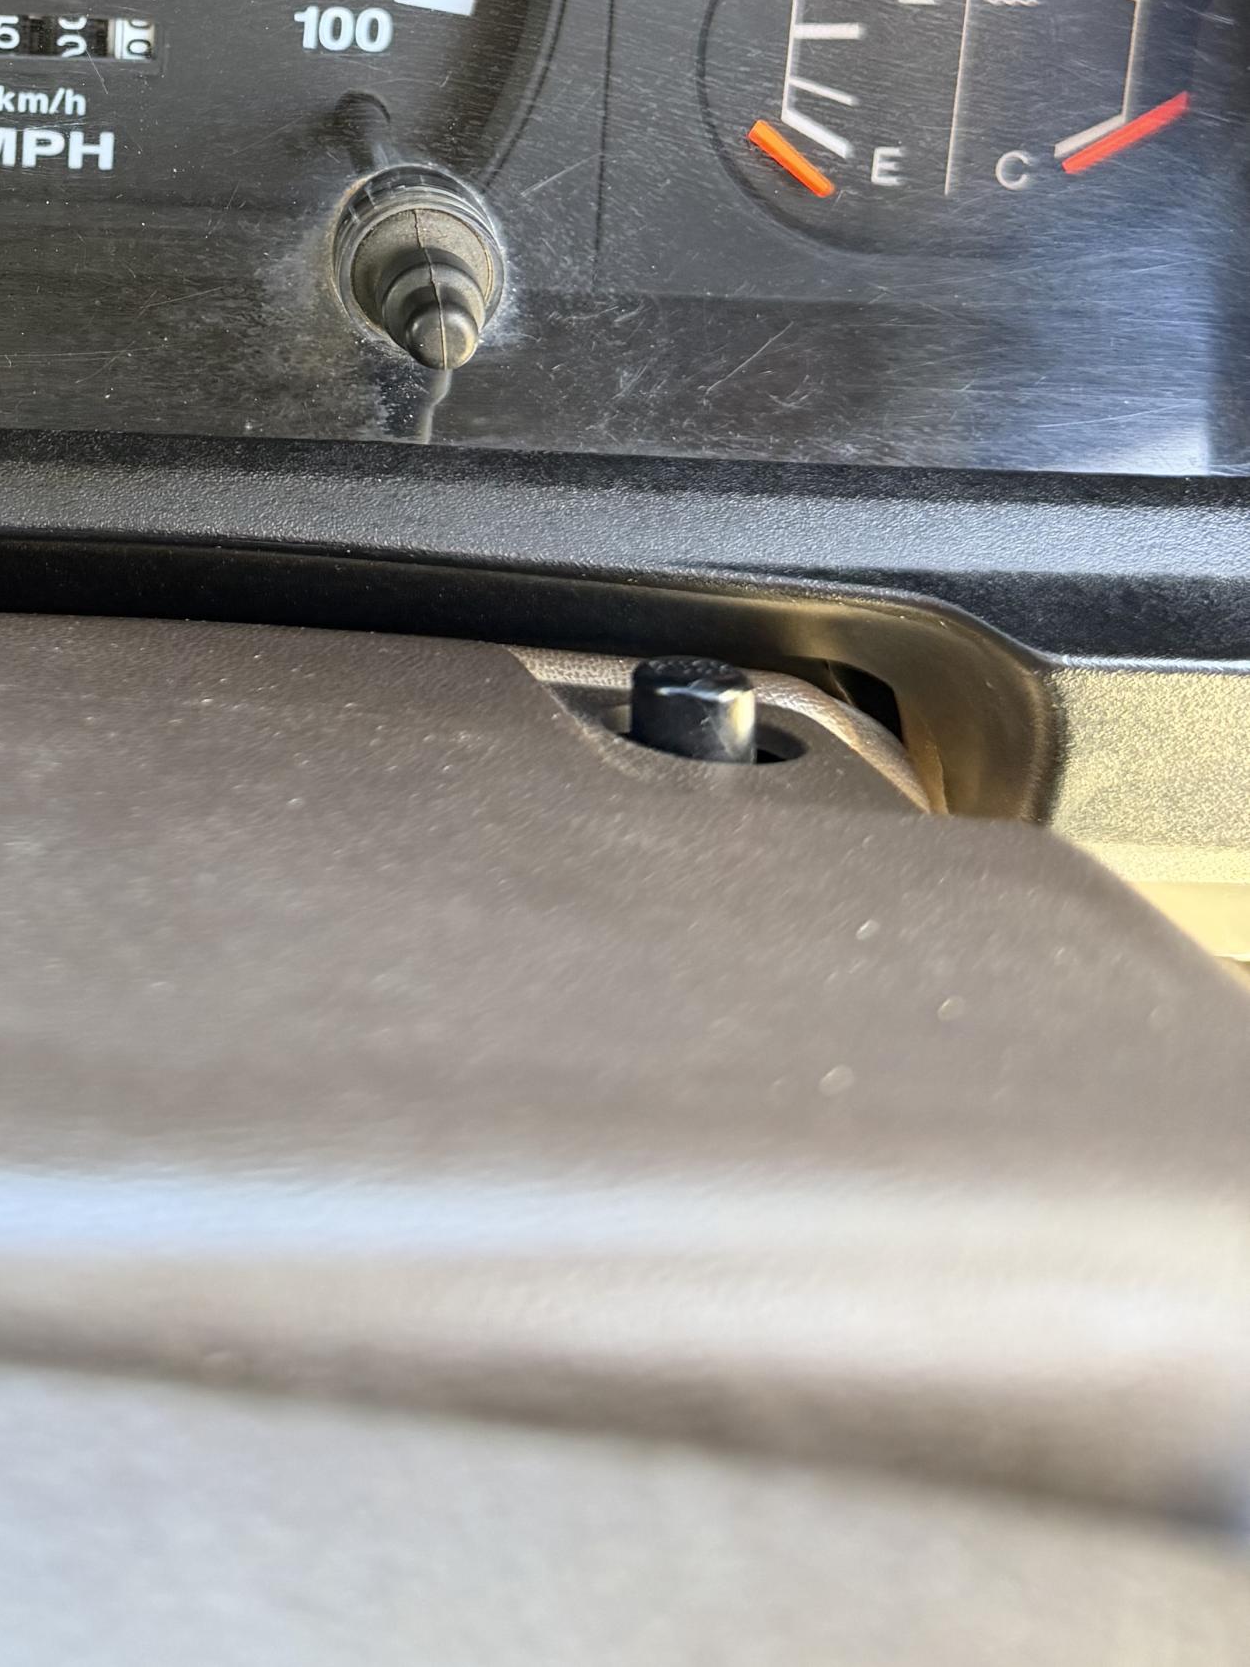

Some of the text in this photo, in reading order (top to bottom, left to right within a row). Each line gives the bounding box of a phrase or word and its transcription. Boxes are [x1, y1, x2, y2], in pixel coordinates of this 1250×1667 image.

[294, 5, 393, 53] 100
[871, 147, 903, 186] E
[996, 151, 1033, 190] C
